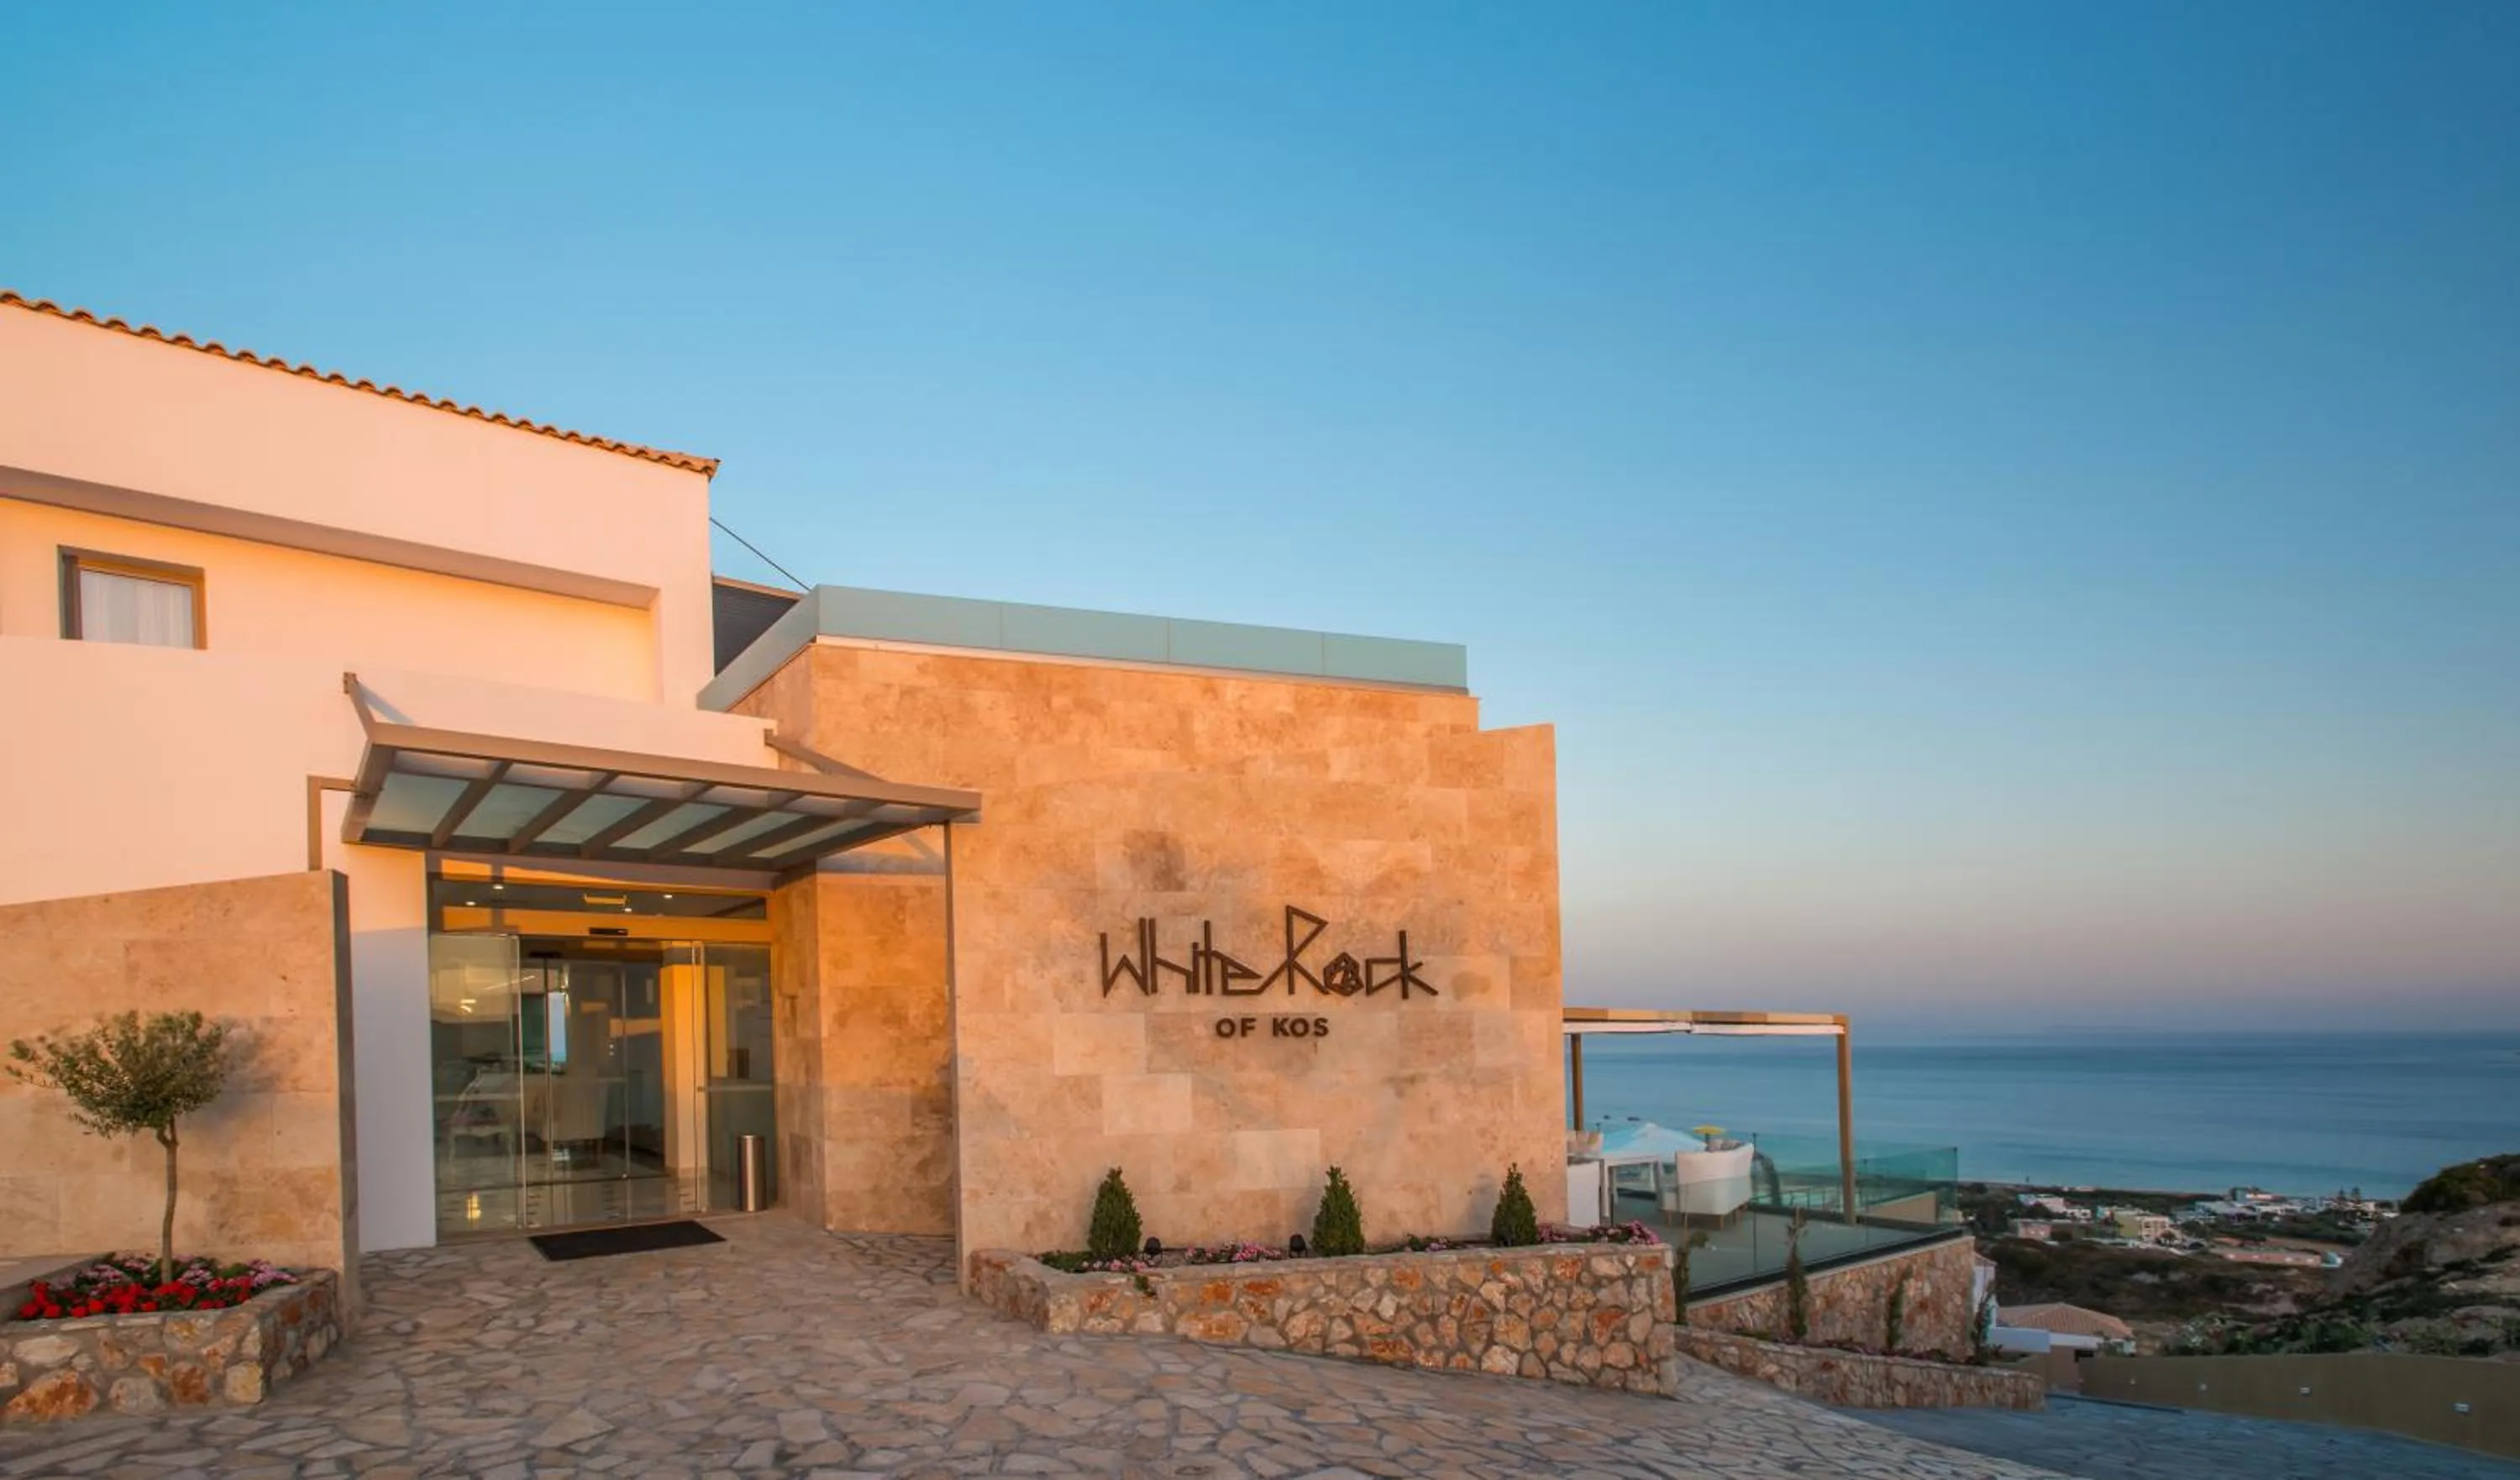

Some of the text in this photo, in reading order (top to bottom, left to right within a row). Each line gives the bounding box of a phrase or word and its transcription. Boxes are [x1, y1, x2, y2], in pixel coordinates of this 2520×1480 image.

[1100, 905, 1439, 1000] White Rock
[1215, 1016, 1330, 1038] OF KOS
